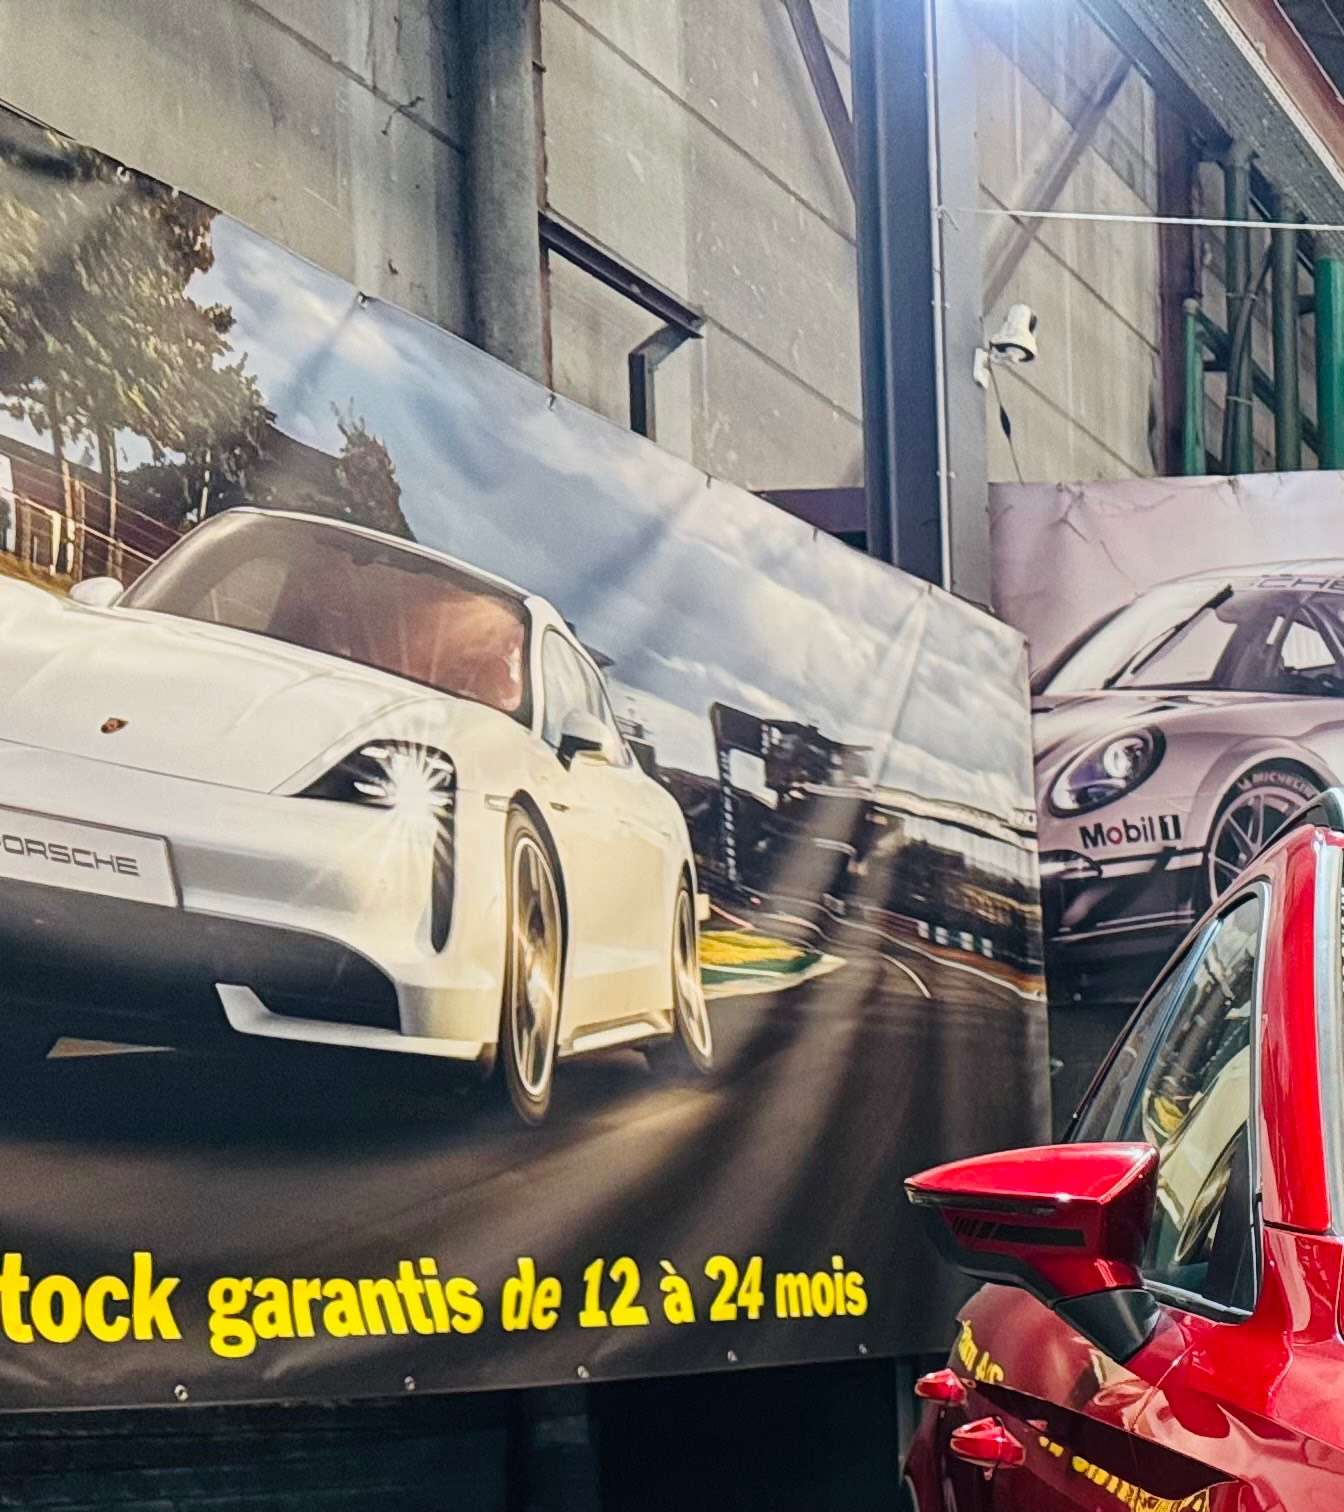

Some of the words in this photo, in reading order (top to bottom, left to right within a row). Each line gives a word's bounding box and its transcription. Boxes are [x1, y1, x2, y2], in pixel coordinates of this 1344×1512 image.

[1078, 815, 1156, 849] Mobil
[0, 834, 141, 877] ORSCHE
[207, 1257, 483, 1359] garantis
[500, 1256, 562, 1333] de
[578, 1256, 650, 1329] 12
[658, 1258, 697, 1324] à
[703, 1255, 764, 1322] 24
[774, 1254, 869, 1318] mois
